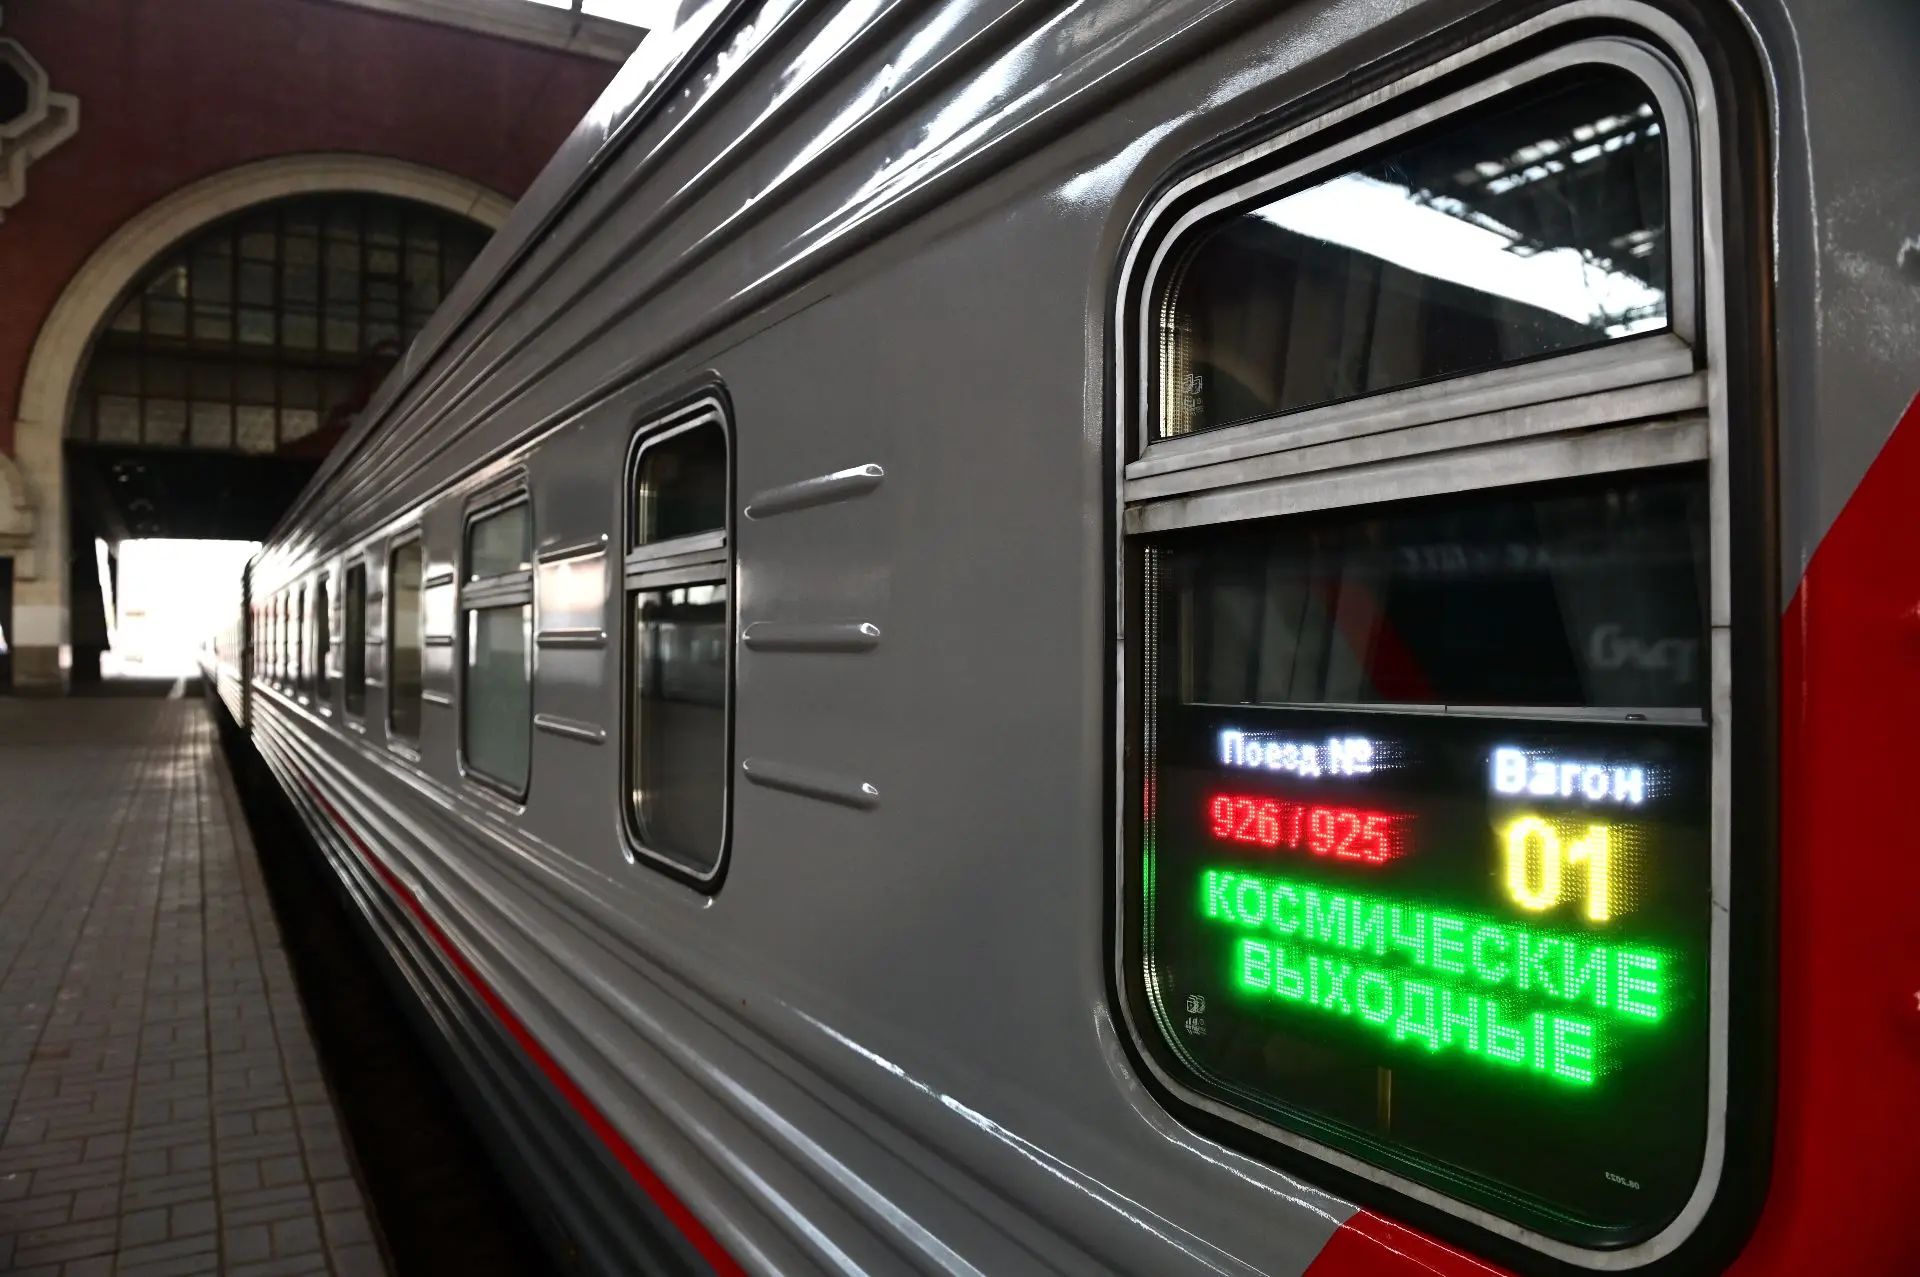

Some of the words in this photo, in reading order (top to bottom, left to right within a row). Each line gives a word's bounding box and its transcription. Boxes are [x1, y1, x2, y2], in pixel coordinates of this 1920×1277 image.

[1221, 730, 1321, 777] Поезд
[1329, 736, 1374, 776] №
[1494, 746, 1644, 804] Вагон
[1507, 816, 1610, 921] 01
[1206, 869, 1660, 1021] КОСМИЧЕСКИЕ
[1240, 937, 1593, 1084] ВЫХОДНЫЕ
